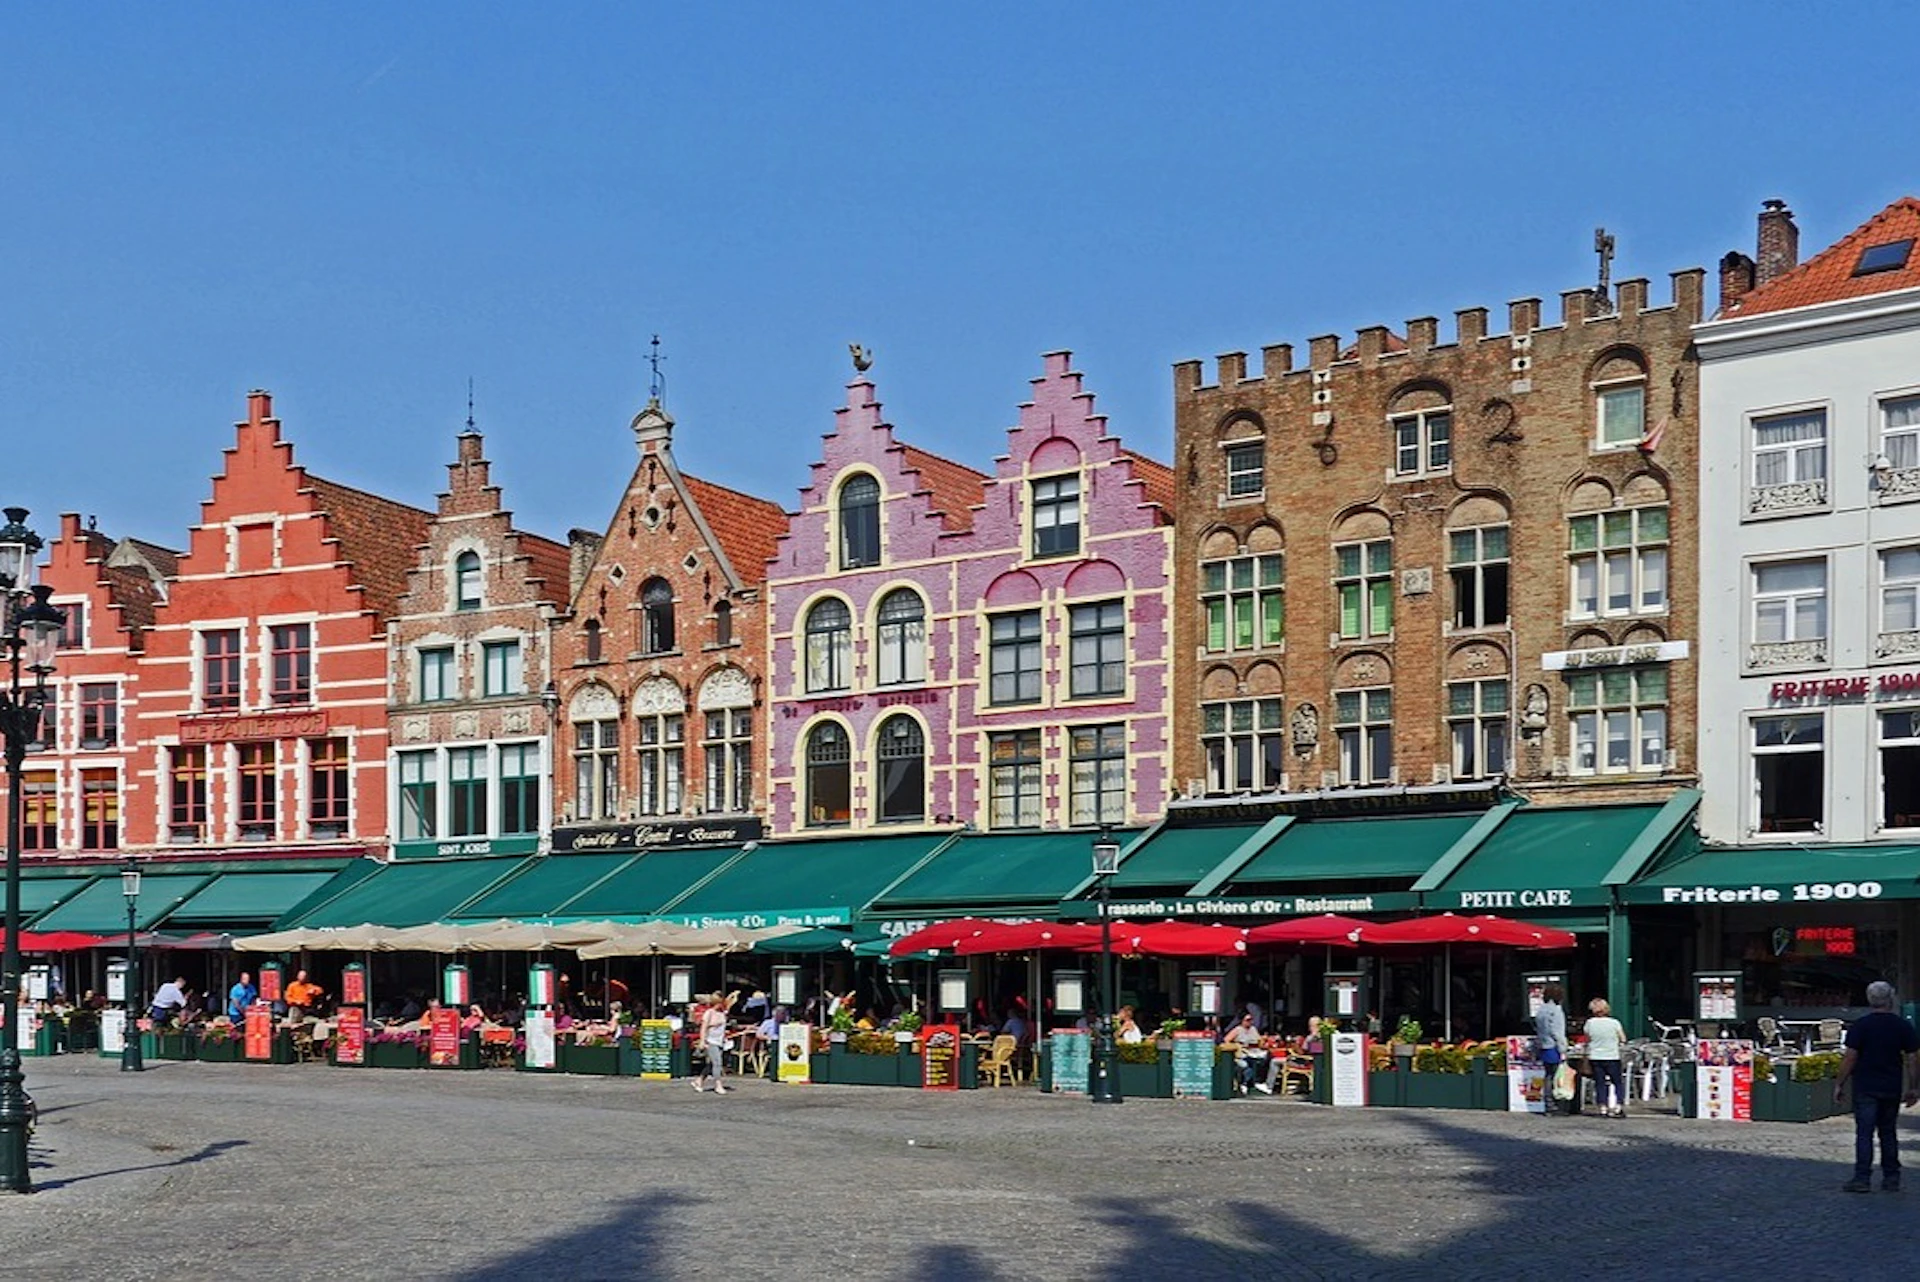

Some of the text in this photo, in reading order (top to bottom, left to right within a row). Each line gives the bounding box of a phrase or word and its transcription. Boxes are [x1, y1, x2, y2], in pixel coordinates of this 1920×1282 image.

[1771, 676, 1870, 701] FRITERIE
[1460, 889, 1572, 908] PETIT CAFE
[1662, 882, 1882, 903] Friterie 1900
[1176, 902, 1194, 914] La
[1250, 899, 1282, 913] d'Or
[1295, 896, 1373, 912] Restaurant
[1796, 927, 1855, 940] FRITERIE
